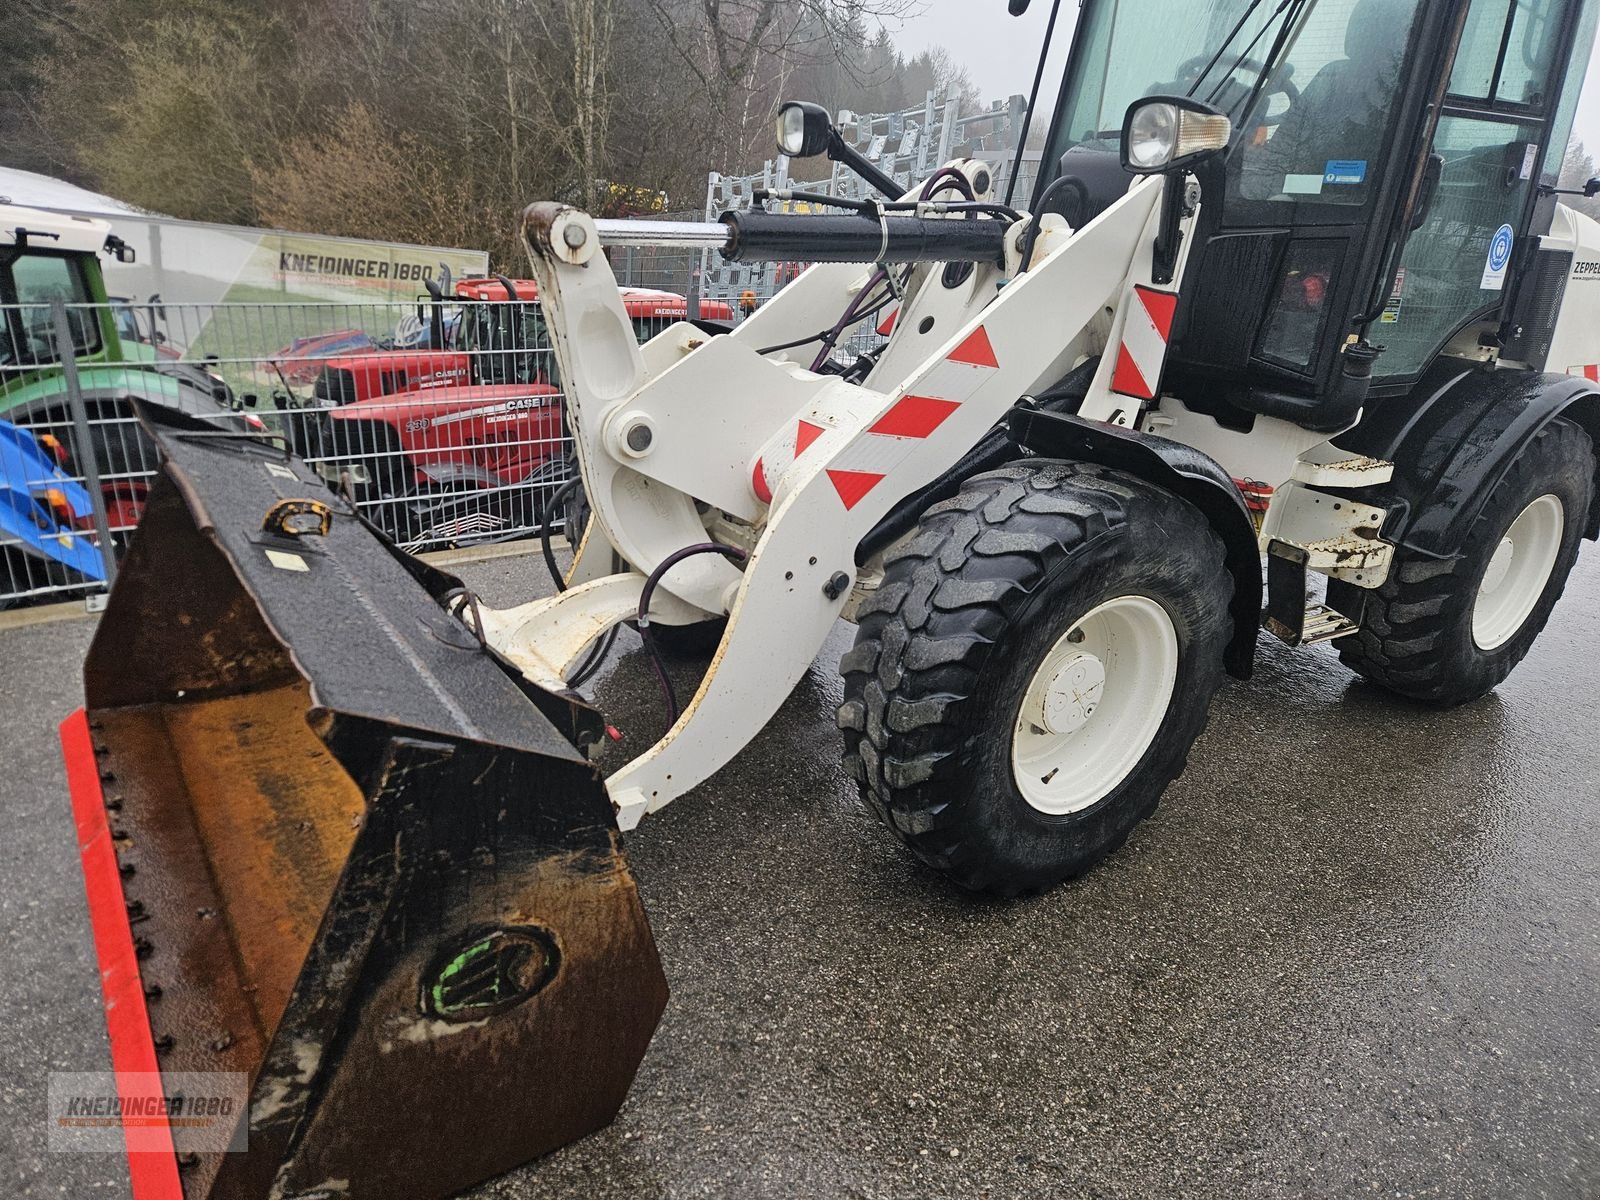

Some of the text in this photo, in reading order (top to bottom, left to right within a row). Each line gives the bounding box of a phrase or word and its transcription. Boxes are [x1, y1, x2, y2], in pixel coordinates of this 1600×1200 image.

[280, 252, 389, 279] KNEIDINGER
[393, 262, 433, 282] 1880
[506, 398, 540, 411] CASE
